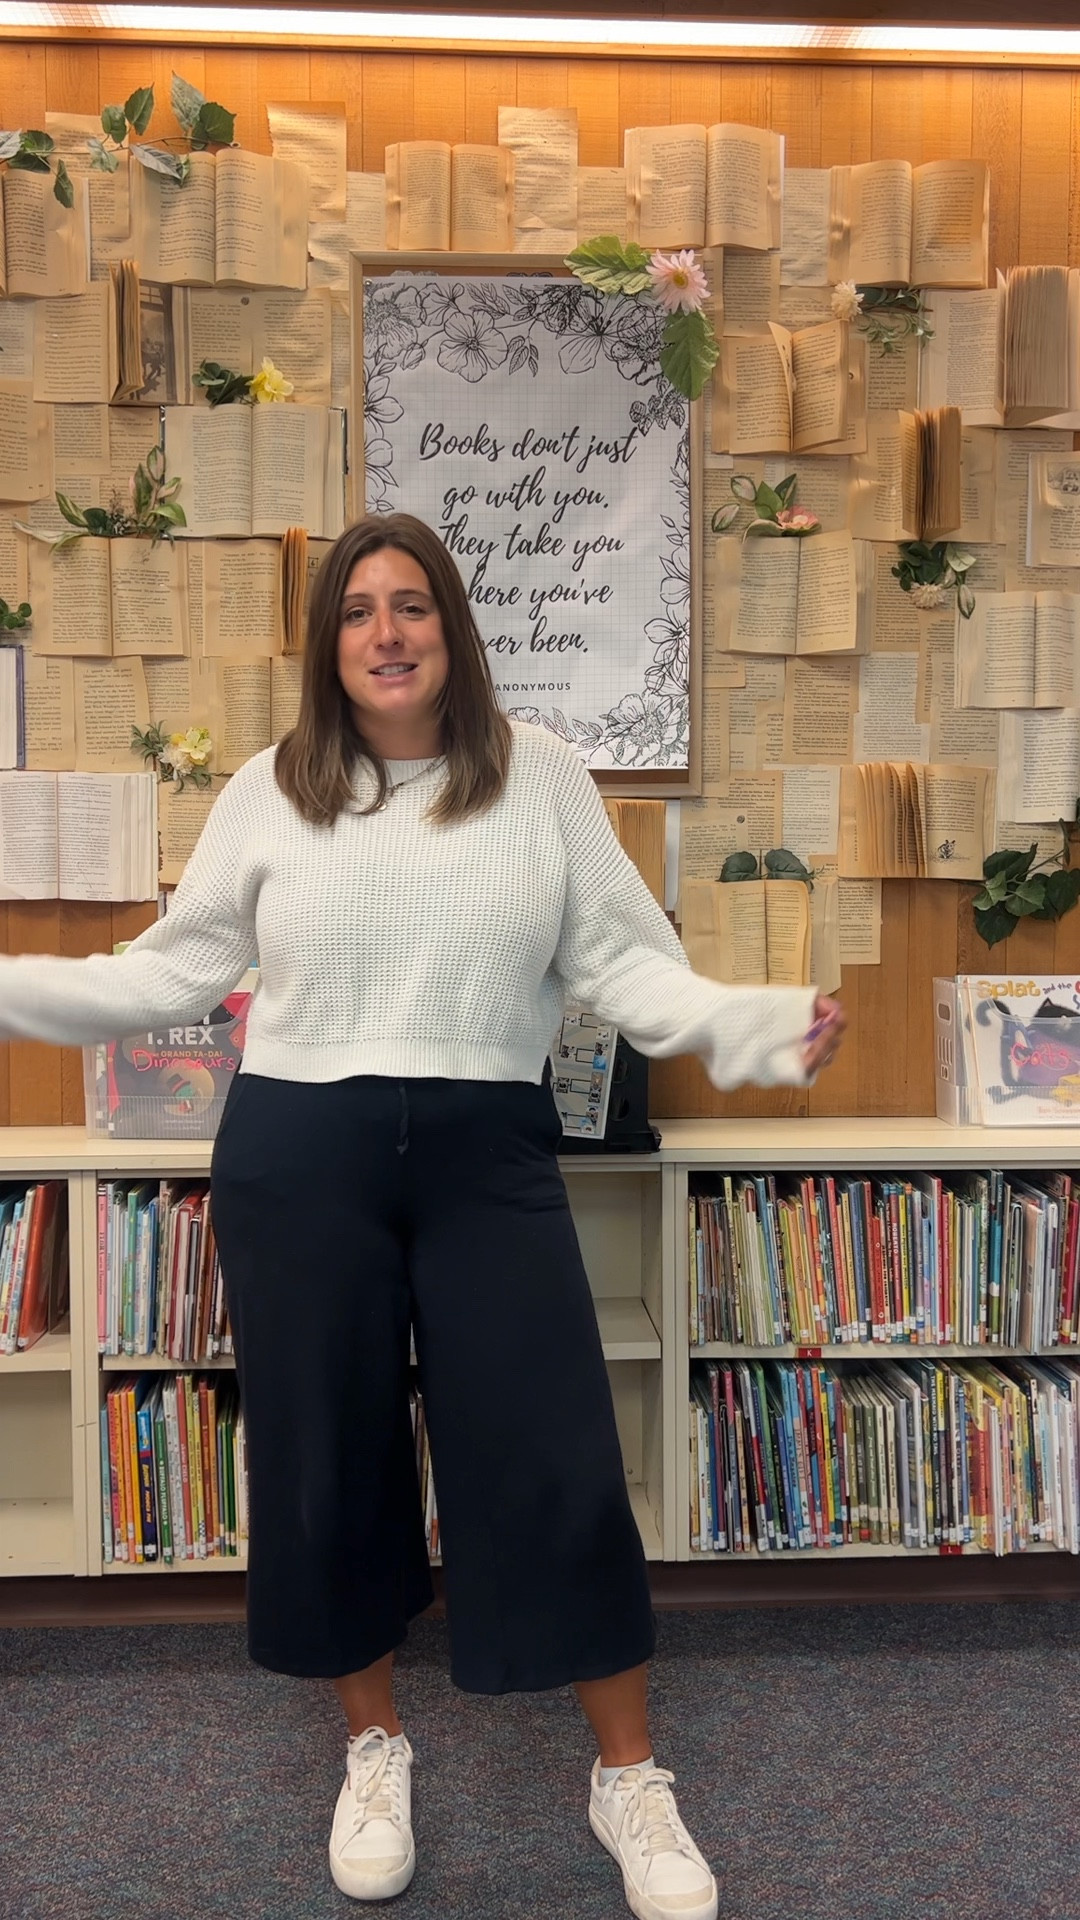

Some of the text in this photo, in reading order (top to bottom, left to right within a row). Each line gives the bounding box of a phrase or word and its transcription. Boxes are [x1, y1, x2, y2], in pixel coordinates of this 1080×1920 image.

[419, 422, 639, 474] Books don't just
[442, 466, 610, 523] go with you.
[439, 513, 626, 573] They take you
[468, 564, 614, 621] here you've
[483, 616, 589, 655] ver been.
[494, 682, 572, 692] ANONYMOUS
[977, 980, 1072, 1000] Splat and the
[169, 1026, 215, 1045] REX
[160, 1050, 223, 1058] GRAND TA-DA!
[933, 1432, 938, 1442] NO
